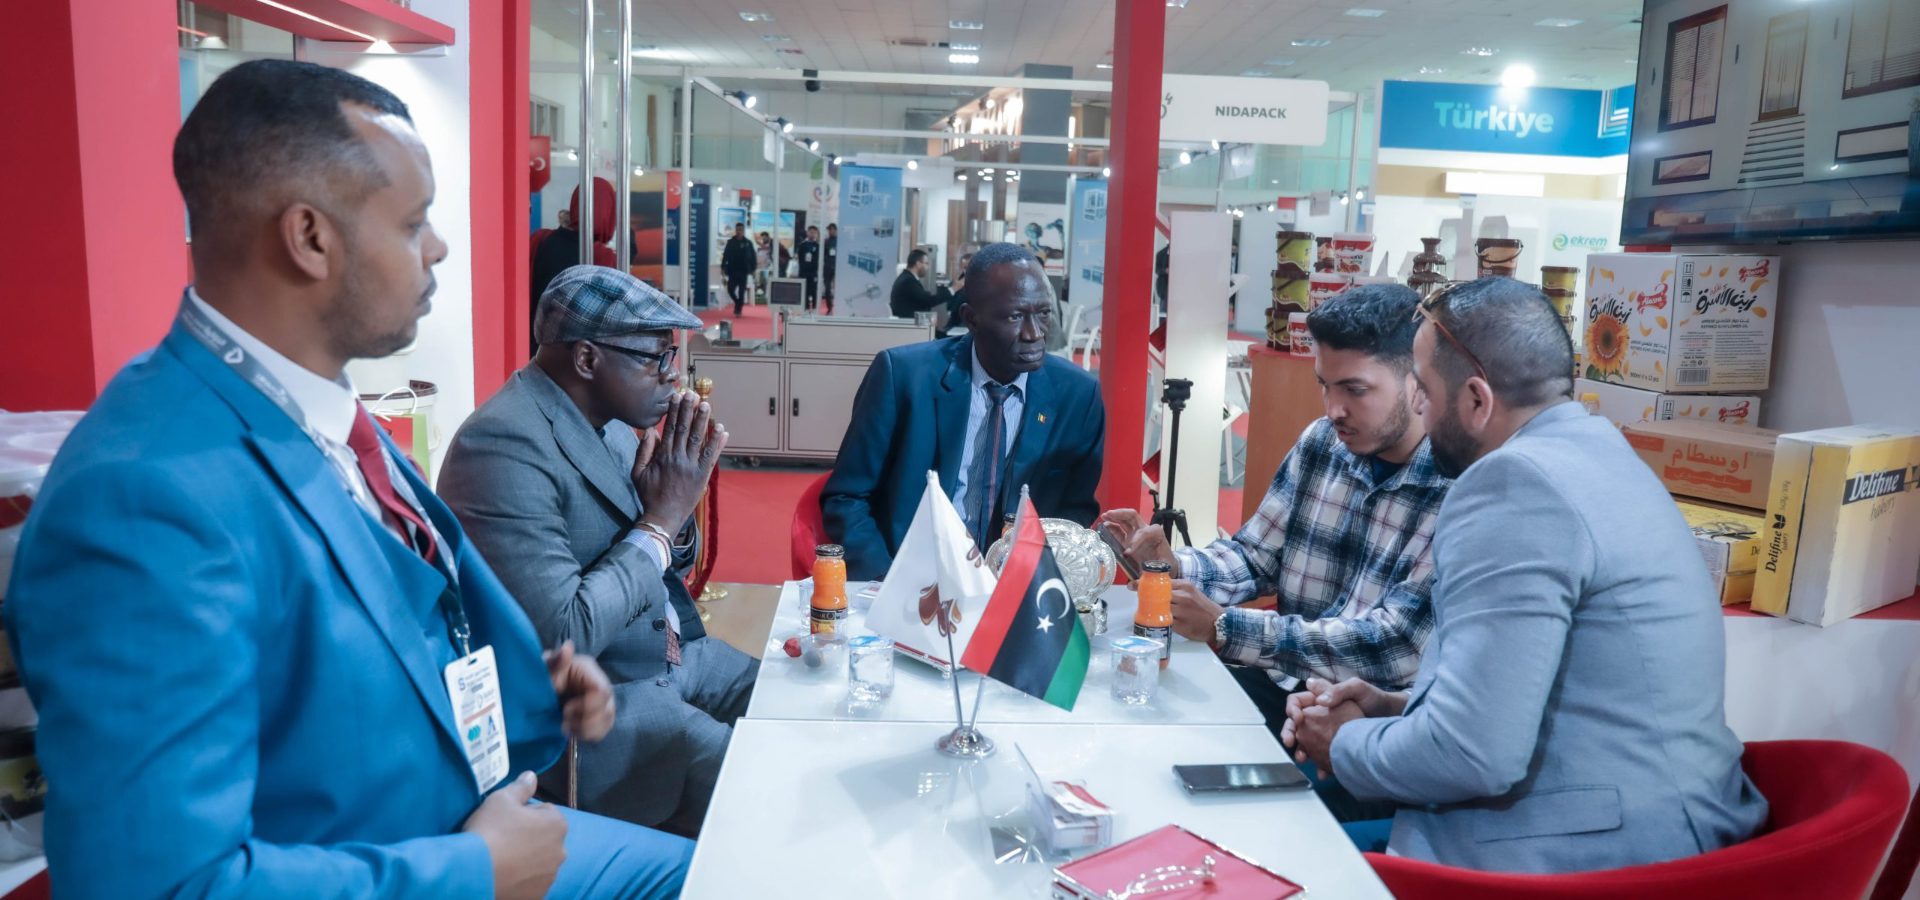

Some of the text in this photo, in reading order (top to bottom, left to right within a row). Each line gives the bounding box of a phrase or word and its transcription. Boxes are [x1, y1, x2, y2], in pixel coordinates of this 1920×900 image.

[1215, 105, 1287, 119] NIDAPACK
[1434, 101, 1554, 138] Türkiye
[1570, 233, 1608, 248] ekrem
[1849, 470, 1900, 502] Delifine
[1765, 530, 1783, 574] Delifine
